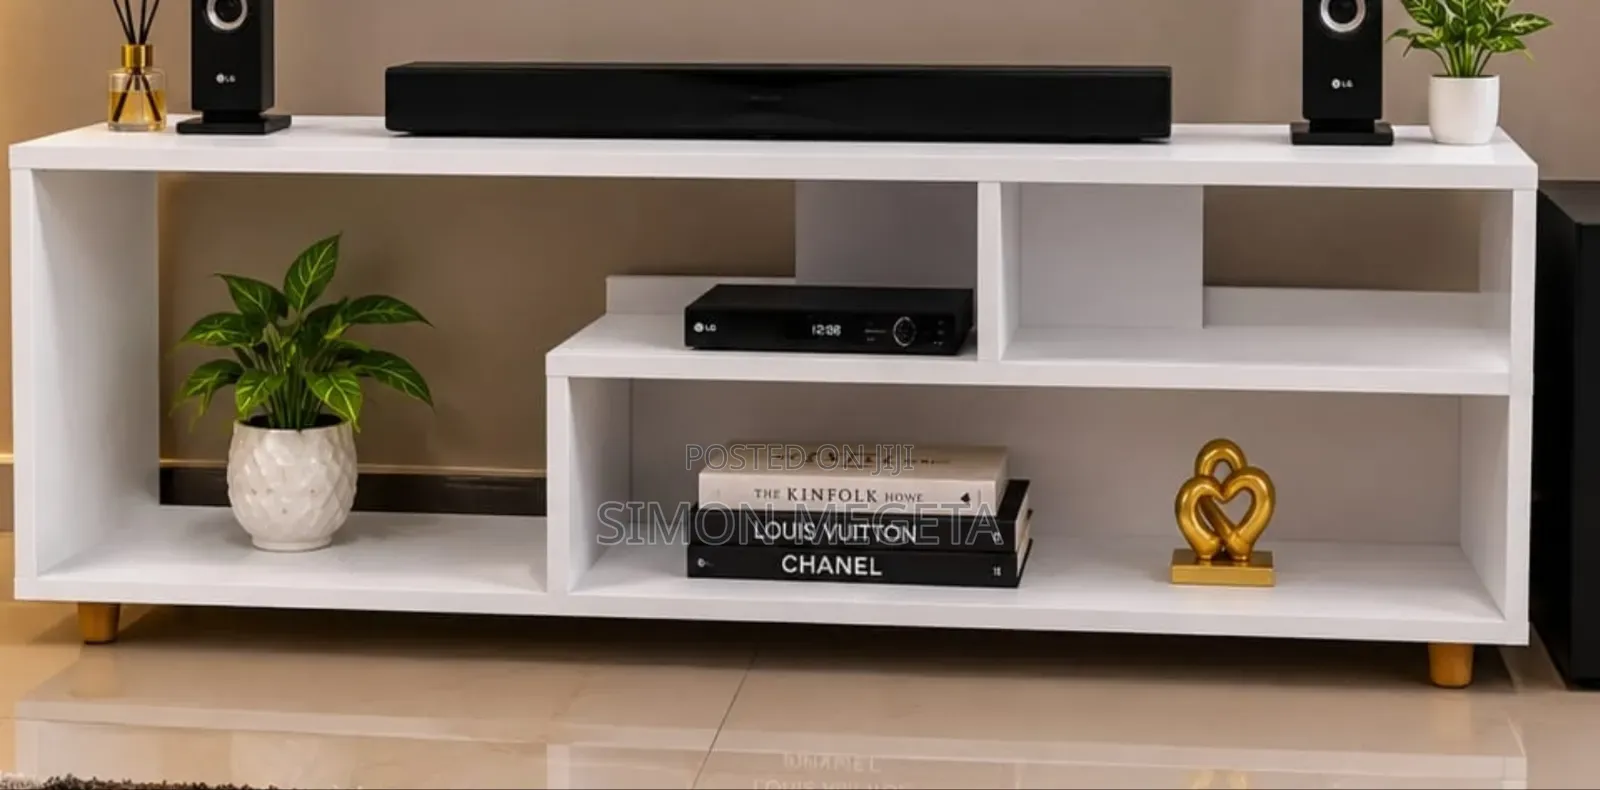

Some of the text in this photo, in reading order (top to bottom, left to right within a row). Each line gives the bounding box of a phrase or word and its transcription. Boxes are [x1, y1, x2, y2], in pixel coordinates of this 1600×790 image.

[754, 489, 781, 499] THE
[787, 488, 878, 502] KINFOLK
[754, 524, 917, 543] LOUIS VUITTON
[782, 555, 882, 576] CHANEL
